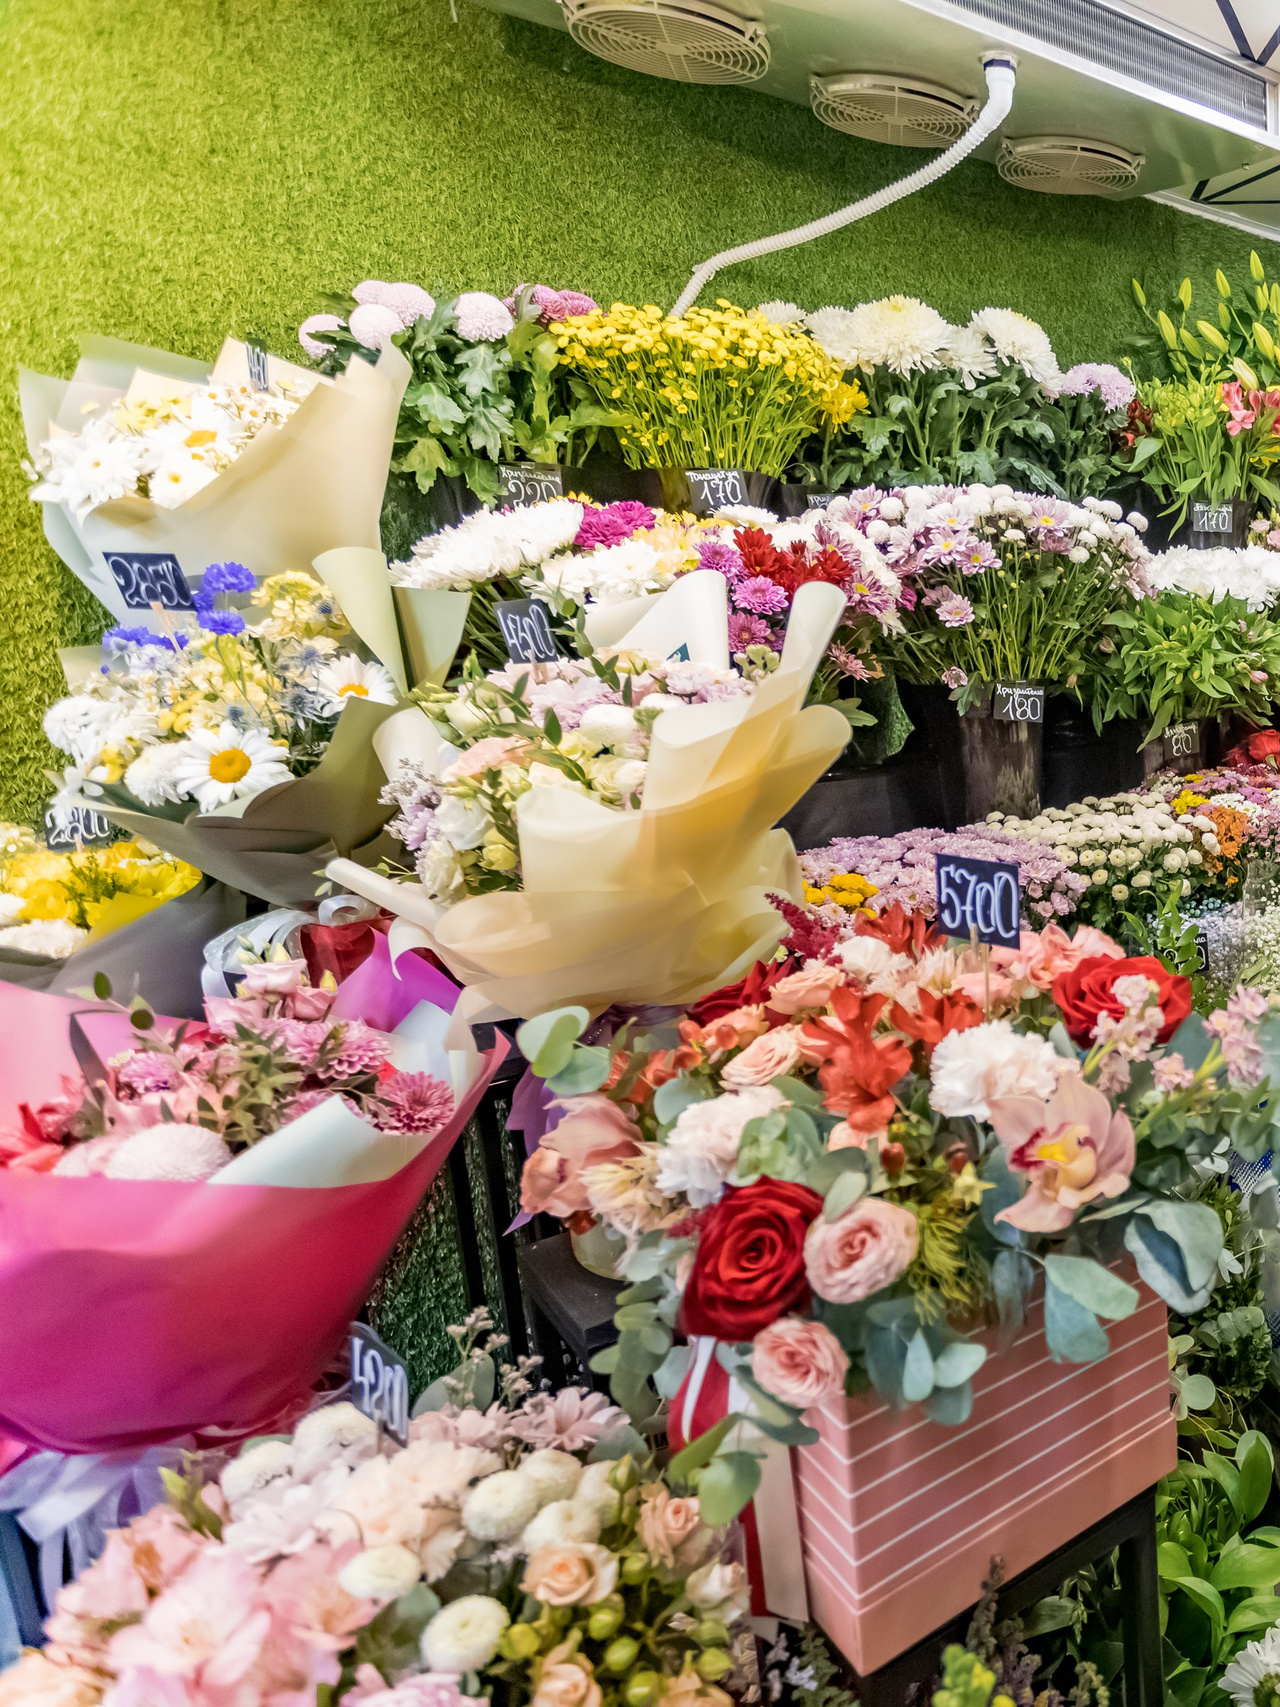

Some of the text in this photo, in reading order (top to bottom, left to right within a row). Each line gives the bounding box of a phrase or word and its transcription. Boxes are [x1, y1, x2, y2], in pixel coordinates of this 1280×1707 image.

[700, 480, 743, 505] 170
[1199, 512, 1228, 531] 170
[111, 556, 191, 606] 2850
[1002, 696, 1041, 721] 180
[1171, 733, 1192, 757] 80
[940, 864, 1018, 938] 5700
